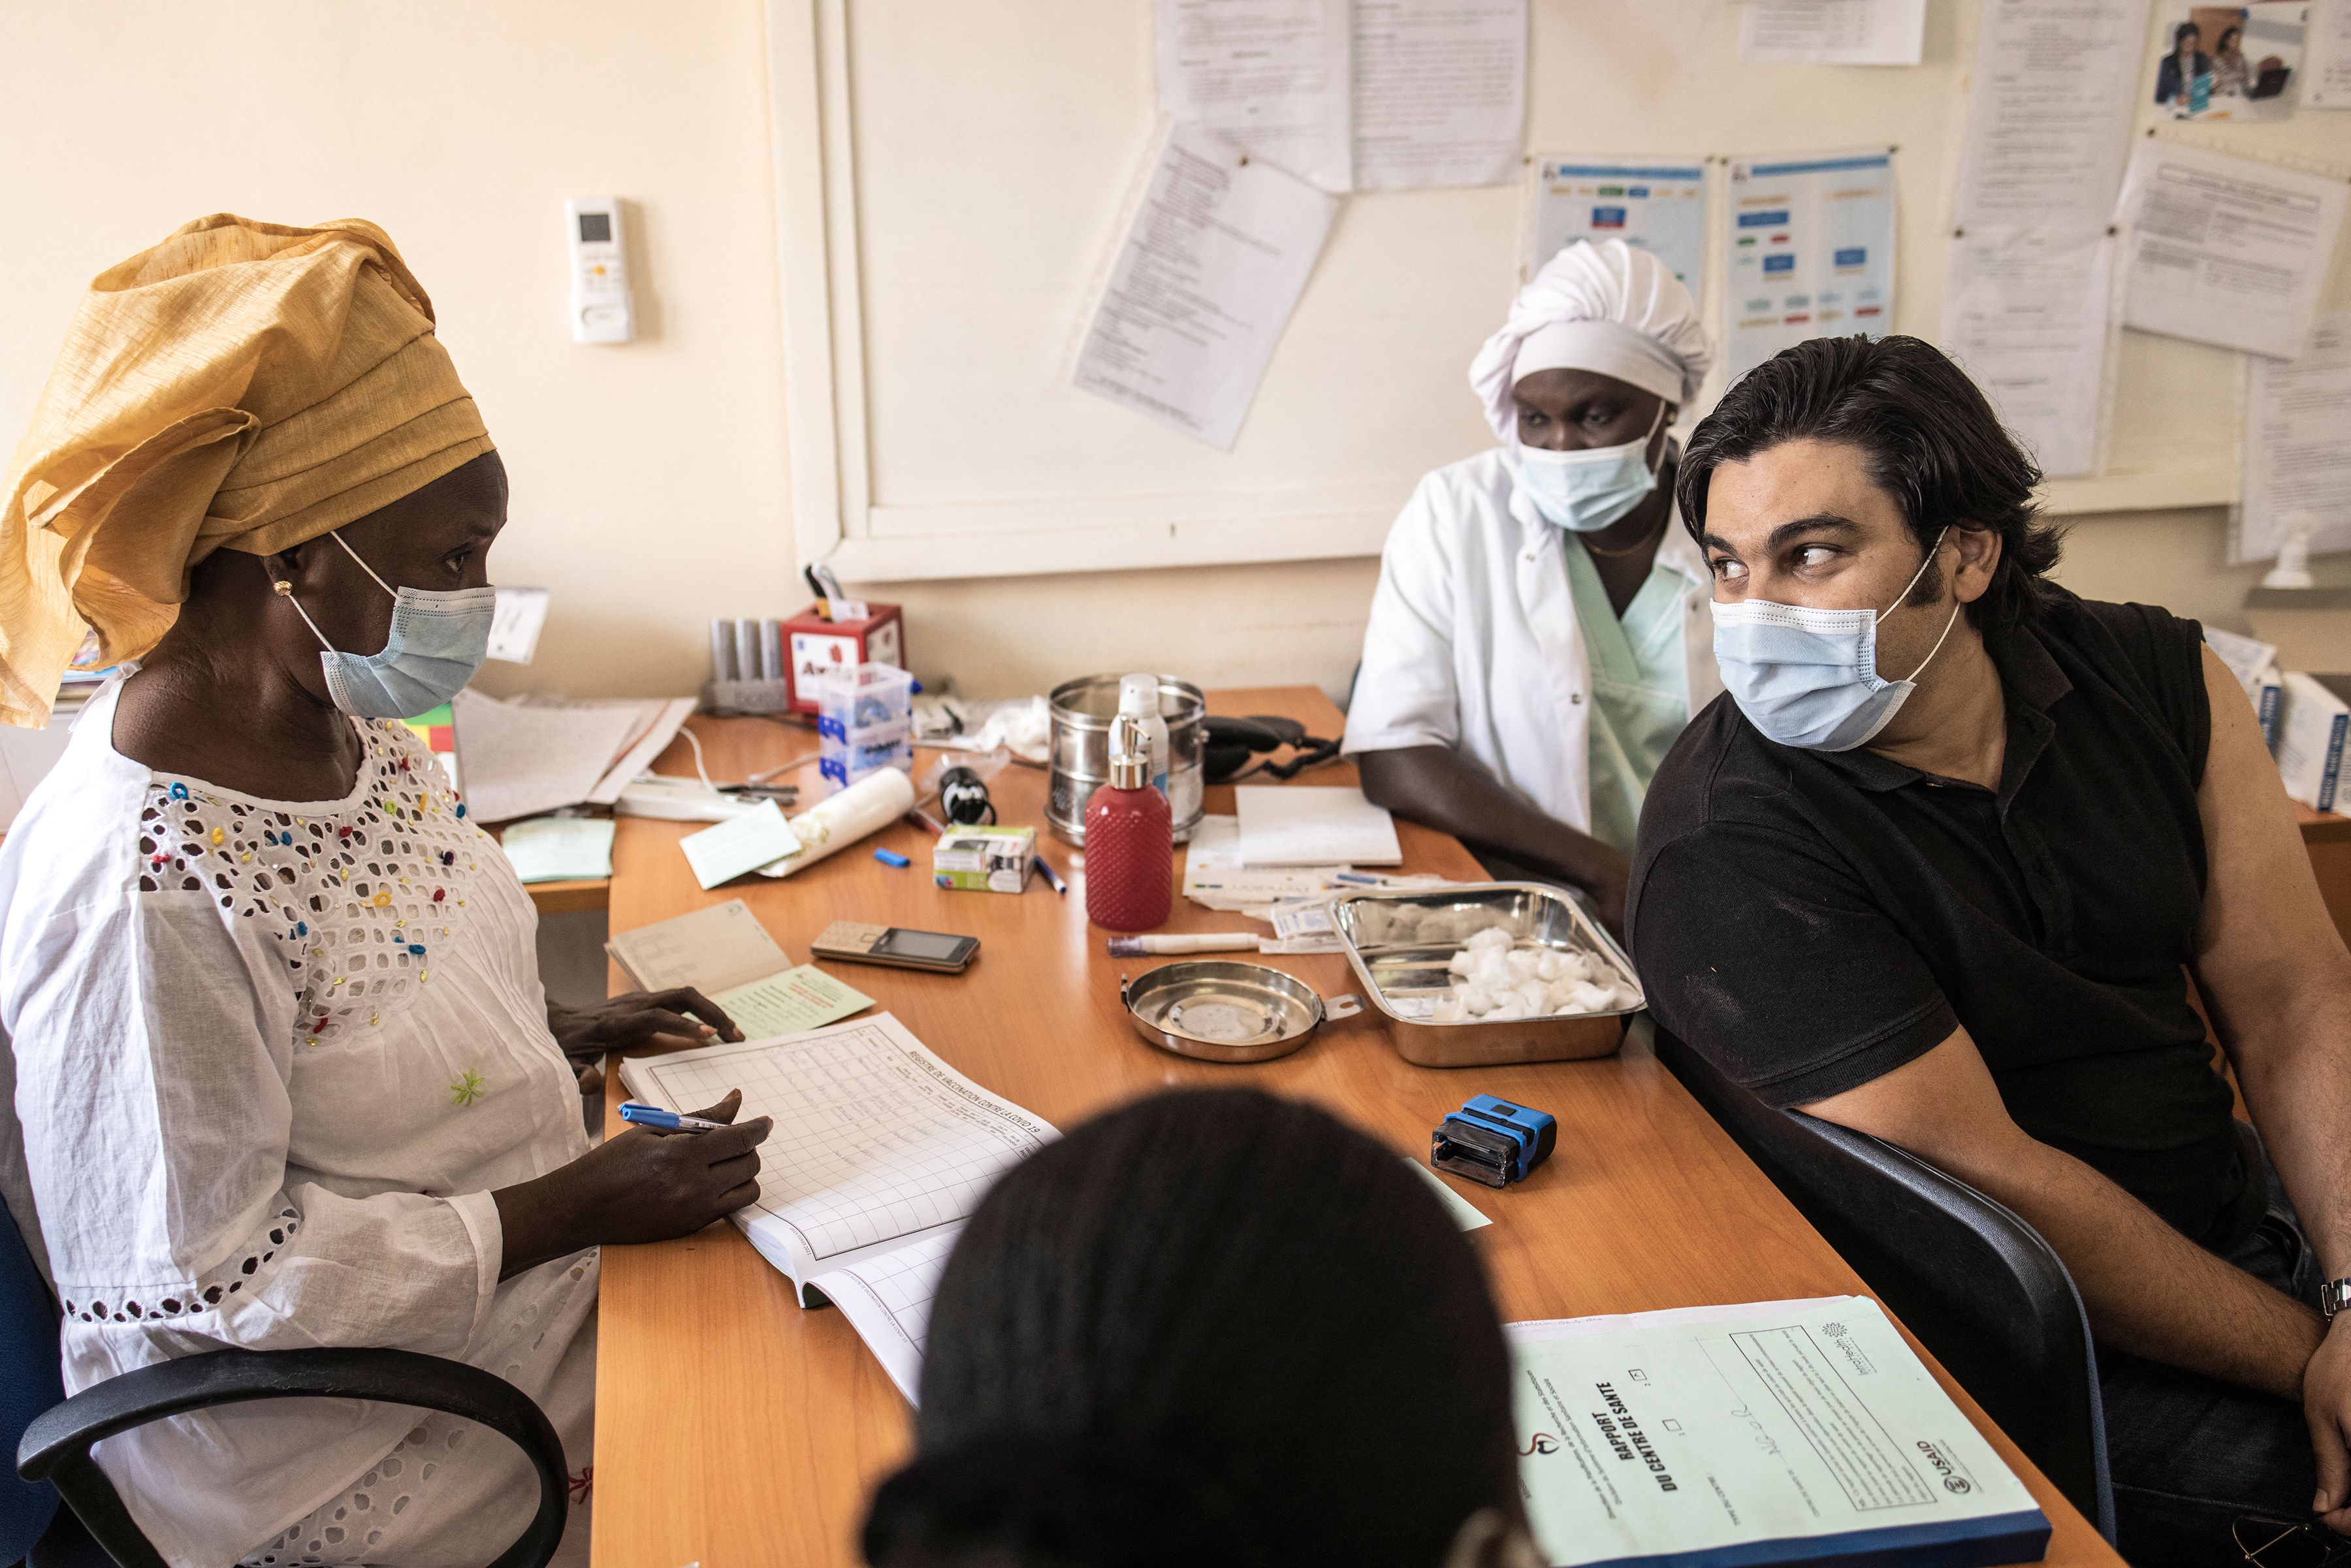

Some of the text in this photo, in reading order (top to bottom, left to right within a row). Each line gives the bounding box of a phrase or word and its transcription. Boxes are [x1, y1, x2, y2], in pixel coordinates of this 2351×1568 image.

[910, 1051, 936, 1072] REGISTRE
[942, 1077, 980, 1101] VACCINATION
[978, 1100, 1004, 1112] CONTRE
[1008, 1115, 1031, 1127] COVID
[864, 1288, 882, 1308] VACCINATION
[880, 1308, 892, 1321] CONTRE
[893, 1326, 904, 1337] COVID
[1749, 1334, 1770, 1359] communautaire
[1834, 1339, 1868, 1375] IntraHealth
[1526, 1369, 1544, 1396] Statistiques
[1544, 1379, 1556, 1394] Sociale
[1550, 1412, 1567, 1435] Recherche
[1557, 1401, 1572, 1421] Sanitaire
[1593, 1413, 1634, 1460] RAPPORT
[1597, 1383, 1677, 1491] DU CENTRE DE SANTE
[1917, 1441, 1951, 1475] USAID
[1607, 1482, 1622, 1505] Division
[1708, 1477, 1725, 1498] CENTRE
[1599, 1494, 1616, 1519] Direction
[1728, 1510, 1740, 1525] TYPE
